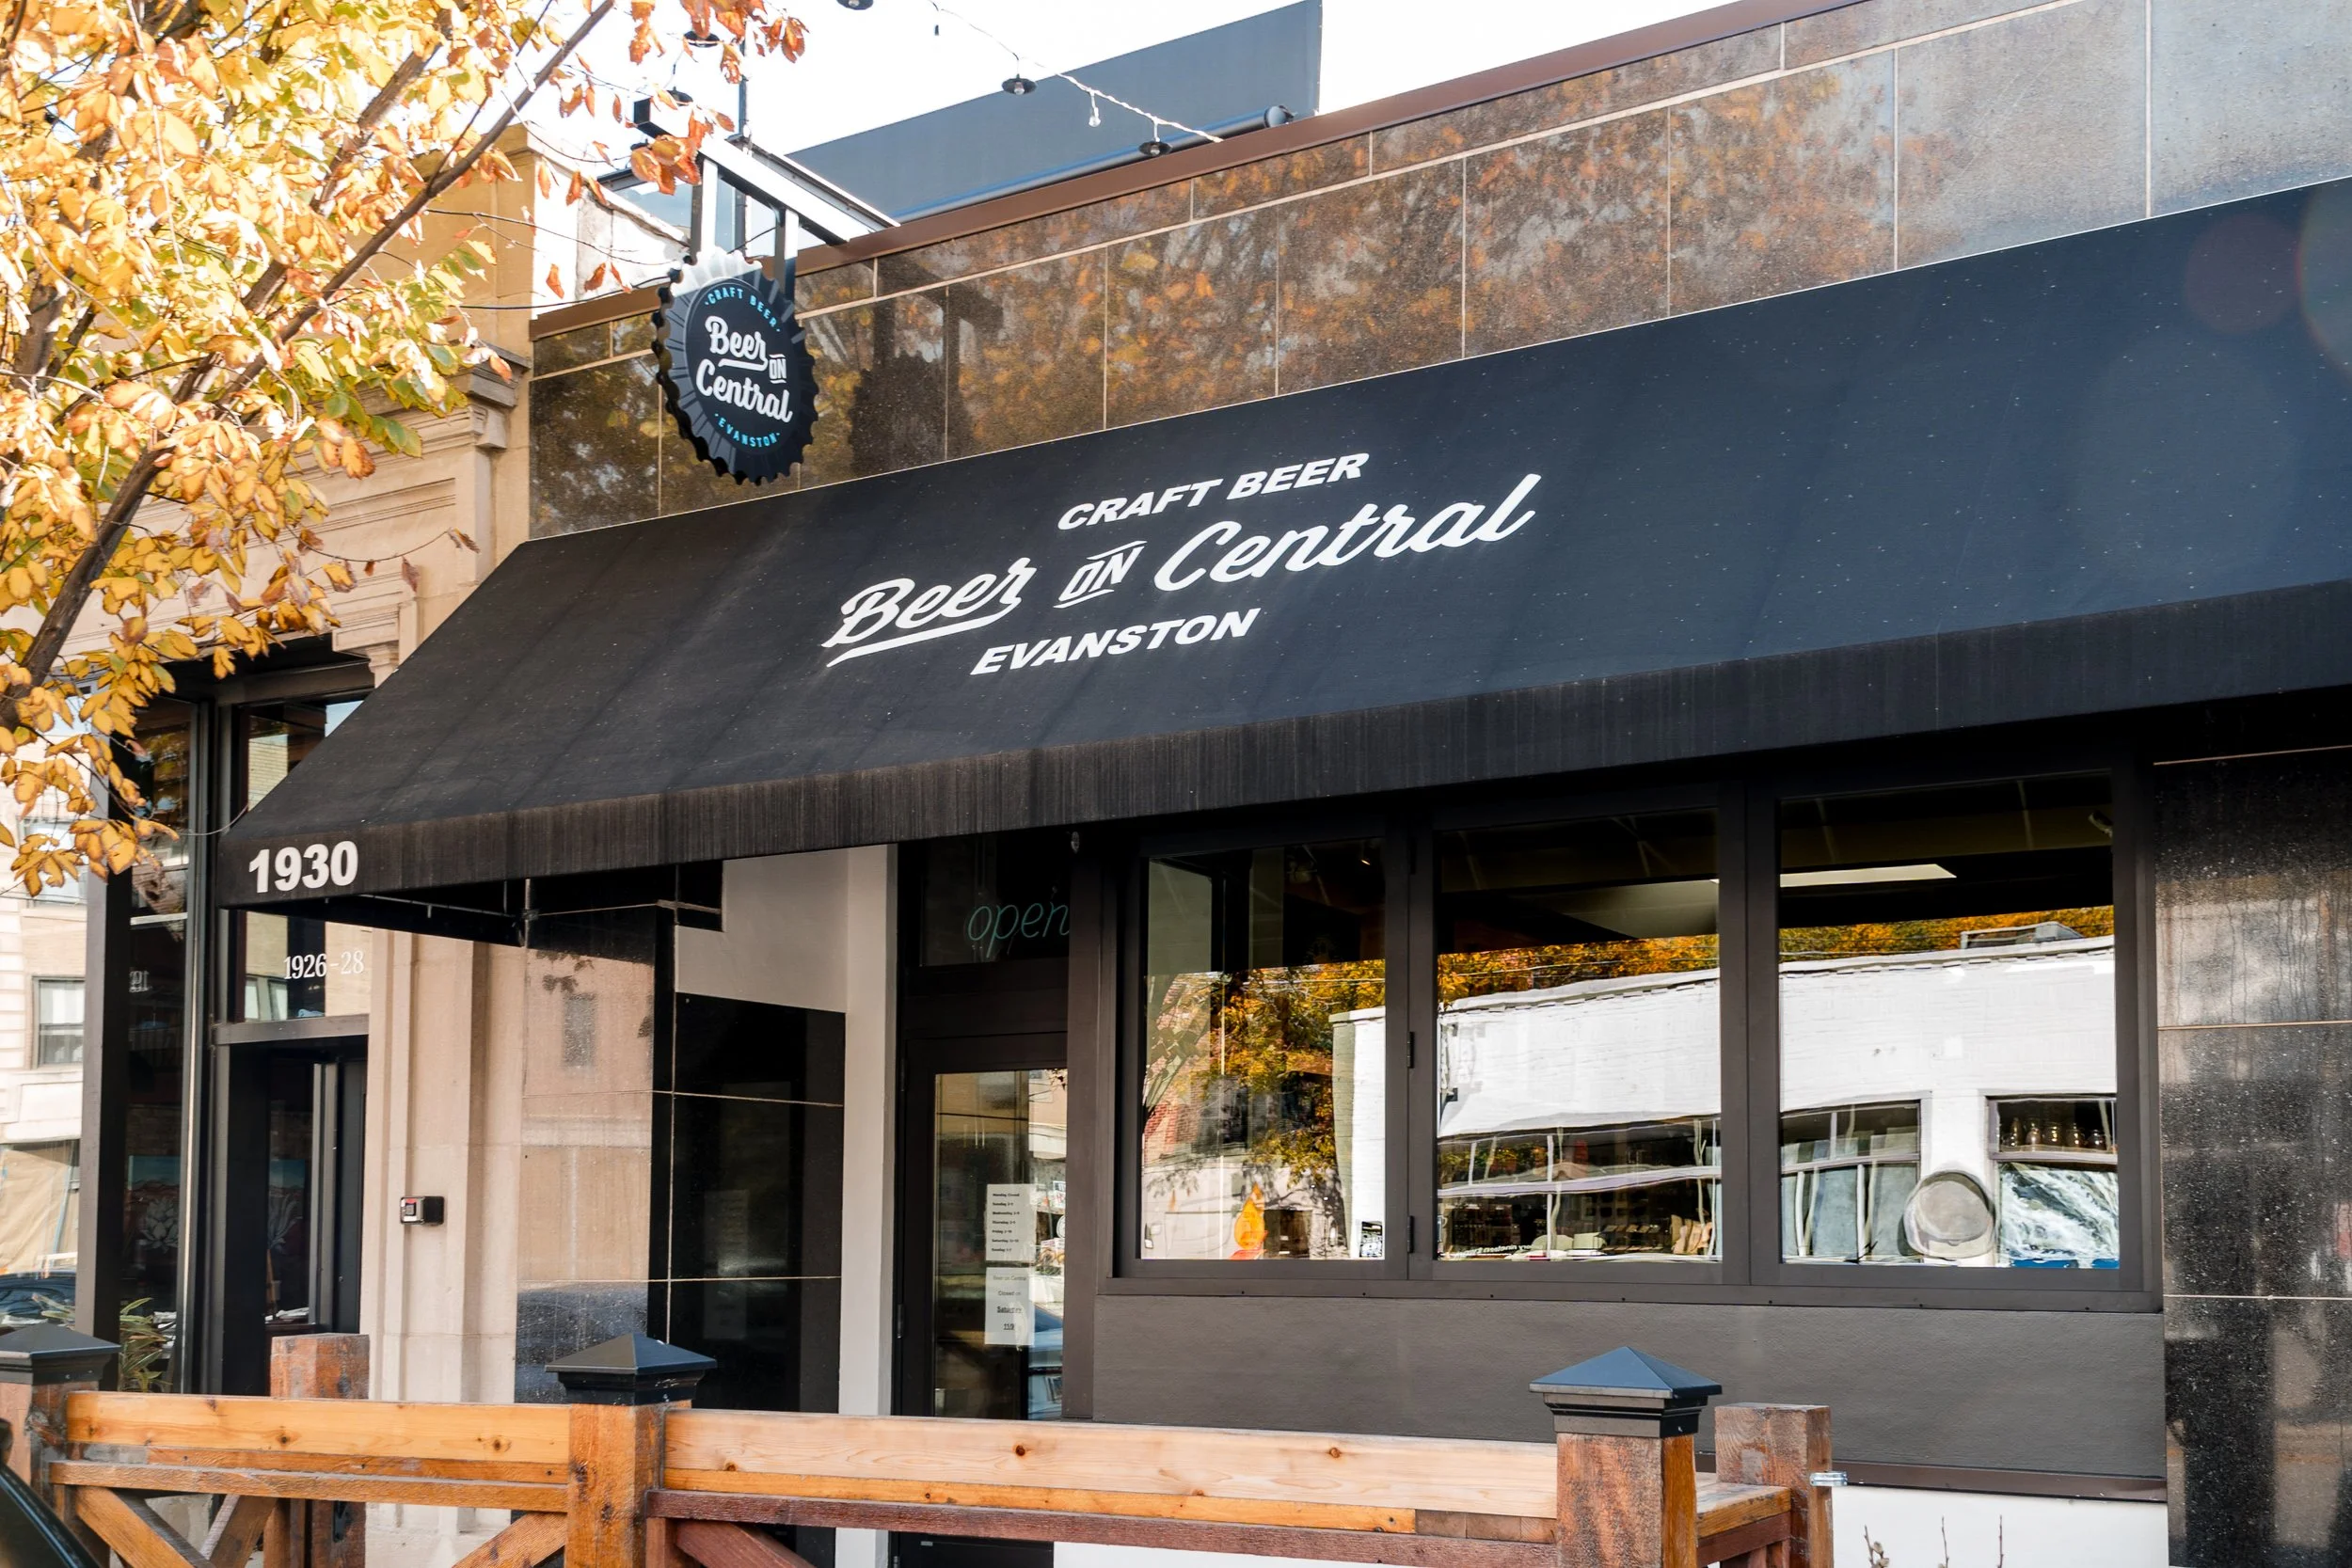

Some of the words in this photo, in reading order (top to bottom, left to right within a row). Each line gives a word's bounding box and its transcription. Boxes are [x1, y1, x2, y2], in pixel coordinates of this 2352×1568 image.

[707, 287, 743, 306] CRAFT
[749, 294, 778, 326] BEER
[705, 315, 769, 372] Beer
[768, 354, 787, 384] ON
[695, 358, 793, 423] Central
[718, 417, 778, 448] EVANSTON
[1057, 479, 1222, 531] CRAFT
[1226, 452, 1370, 500] BEER
[821, 557, 1038, 669] Beer
[1053, 540, 1148, 610] ON
[1153, 473, 1542, 592] Central
[970, 608, 1262, 676] EVANSTON
[248, 840, 359, 894] 1930
[967, 902, 1070, 958] open
